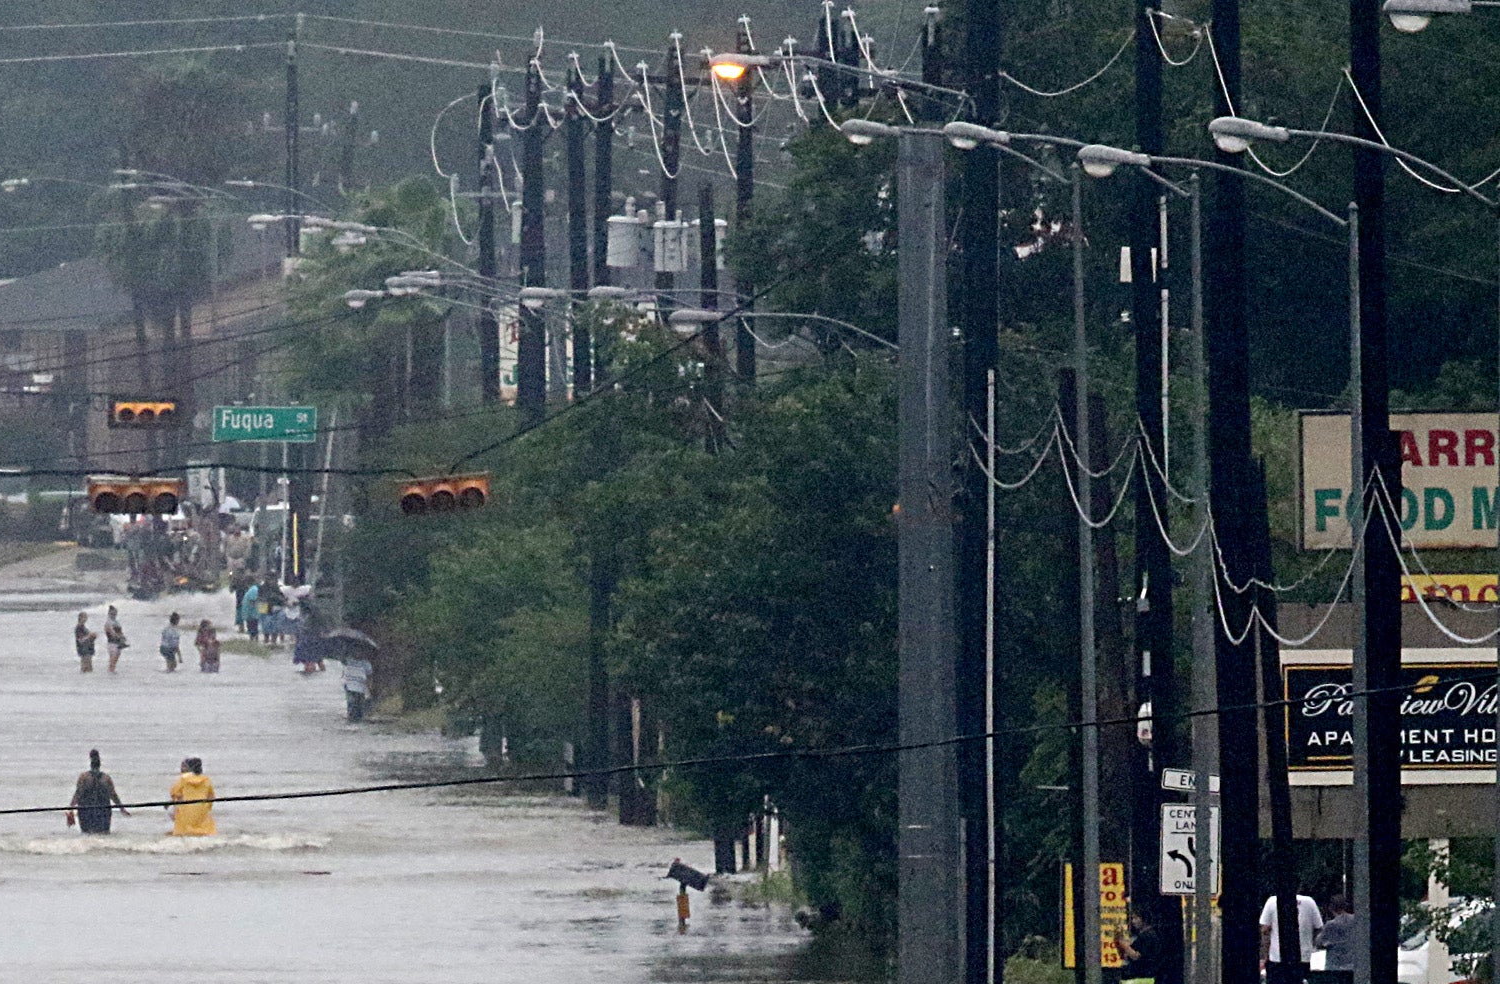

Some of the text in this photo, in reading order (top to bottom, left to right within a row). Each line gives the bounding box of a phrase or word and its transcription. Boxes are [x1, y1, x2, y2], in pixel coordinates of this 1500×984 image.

[221, 409, 274, 432] Fuqua
[1174, 820, 1197, 831] LAN
[1173, 880, 1197, 890] ONL
